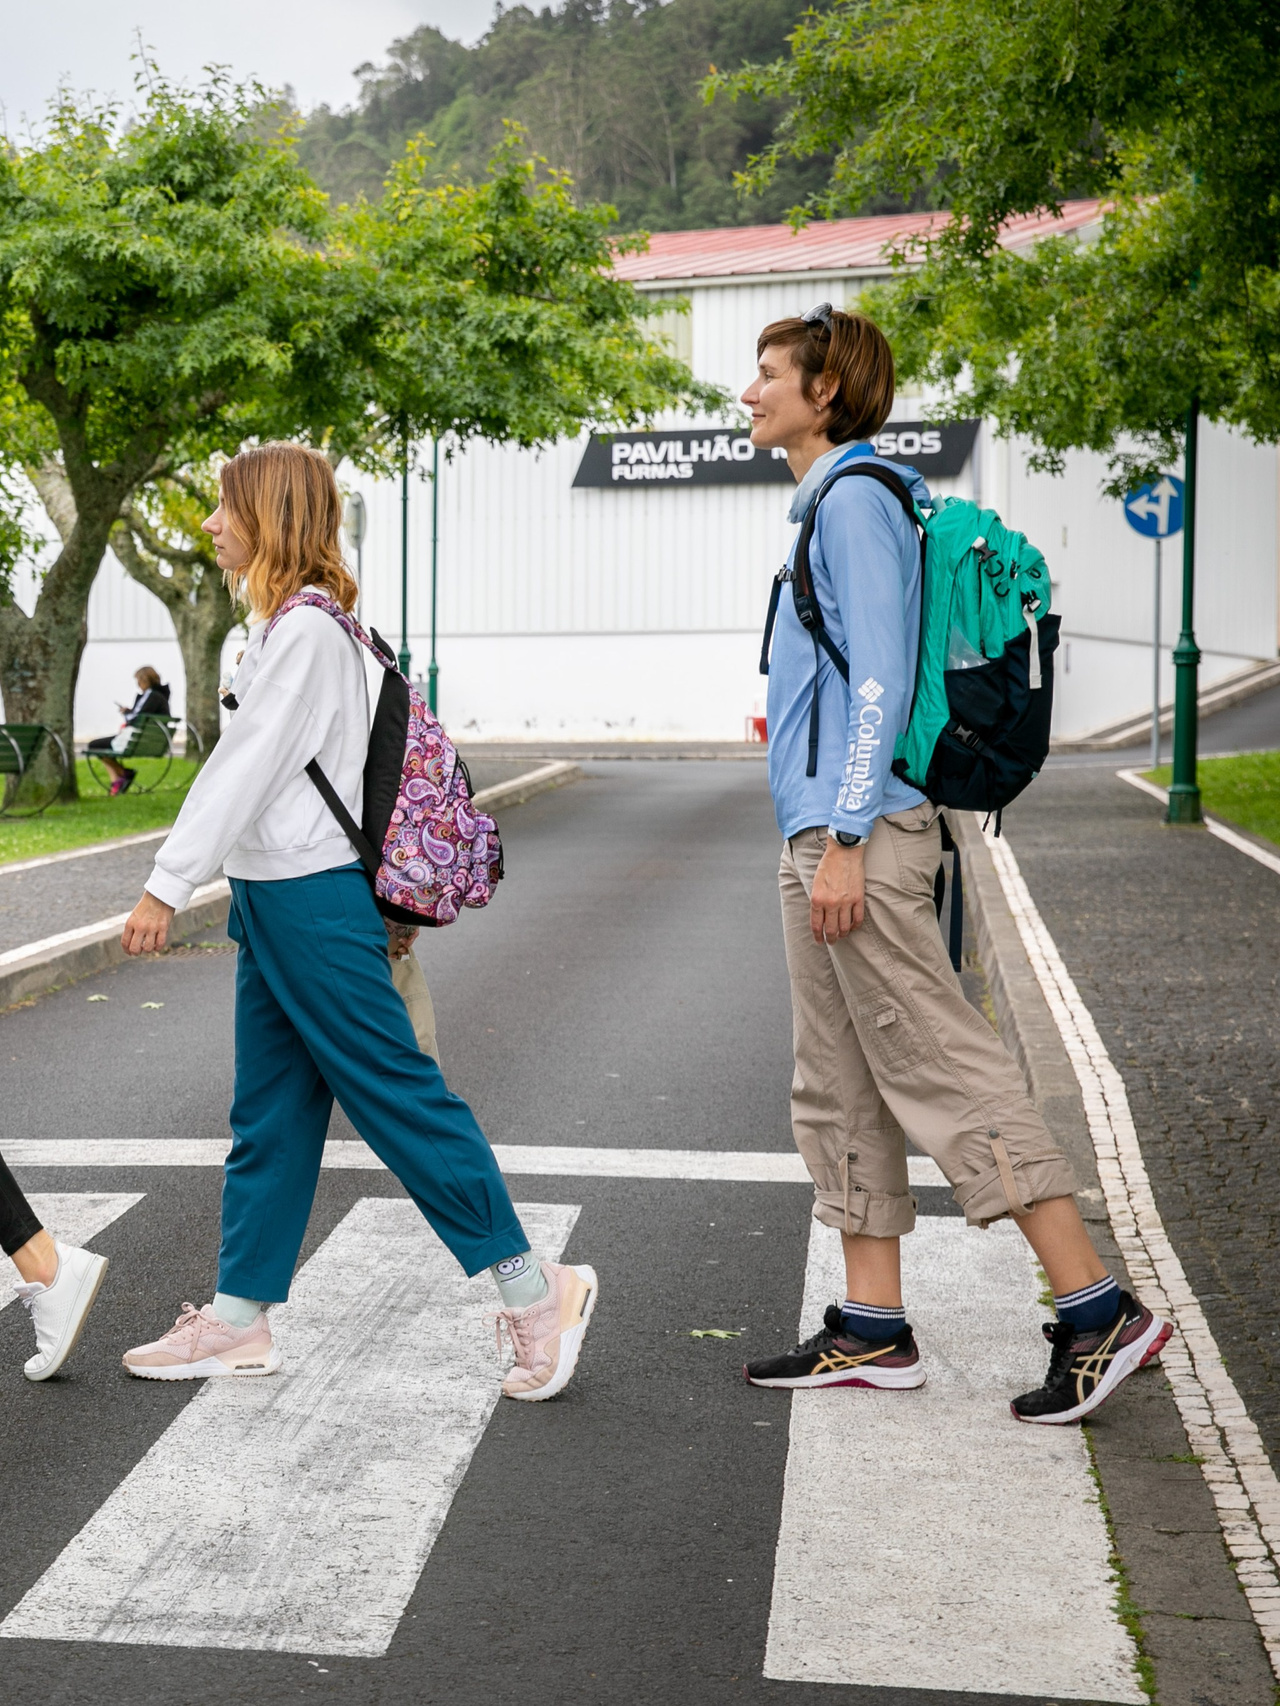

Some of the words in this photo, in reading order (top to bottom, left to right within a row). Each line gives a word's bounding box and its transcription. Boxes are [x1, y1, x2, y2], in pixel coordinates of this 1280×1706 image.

[612, 434, 756, 465] PAVILHÃO
[611, 462, 694, 481] FURNAS
[846, 703, 884, 810] Columbia
